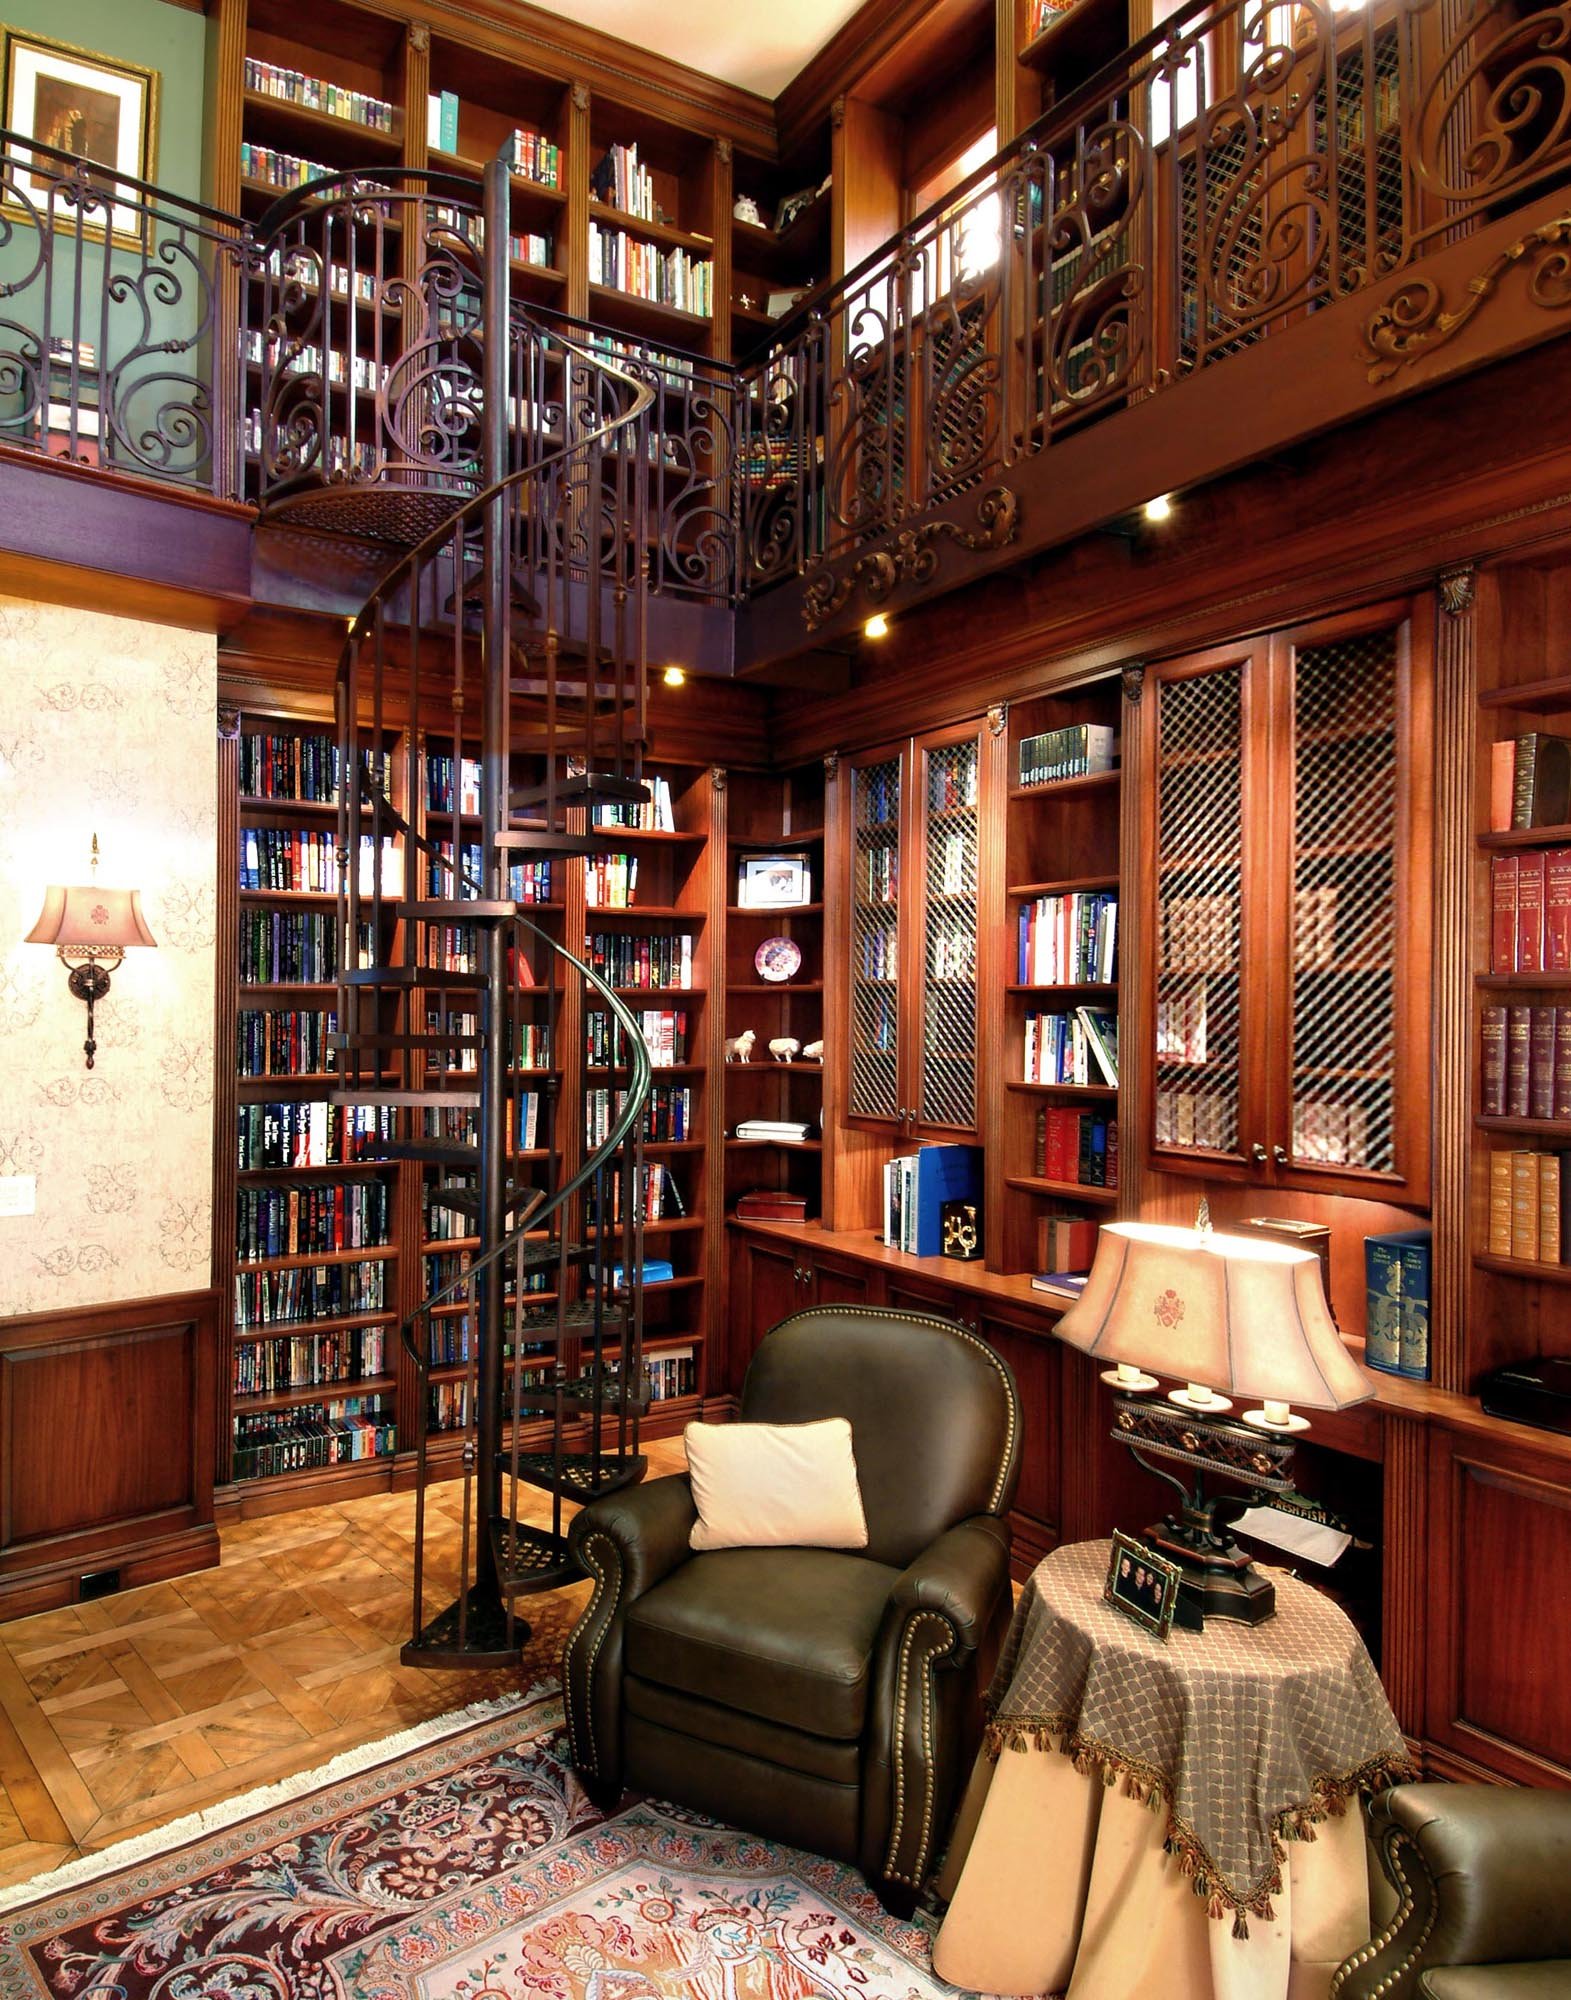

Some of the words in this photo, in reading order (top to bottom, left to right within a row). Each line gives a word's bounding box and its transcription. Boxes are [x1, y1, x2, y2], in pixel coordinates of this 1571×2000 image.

[662, 1027, 674, 1050] KING
[1270, 1498, 1300, 1516] FRESH
[1301, 1509, 1327, 1524] FISH
